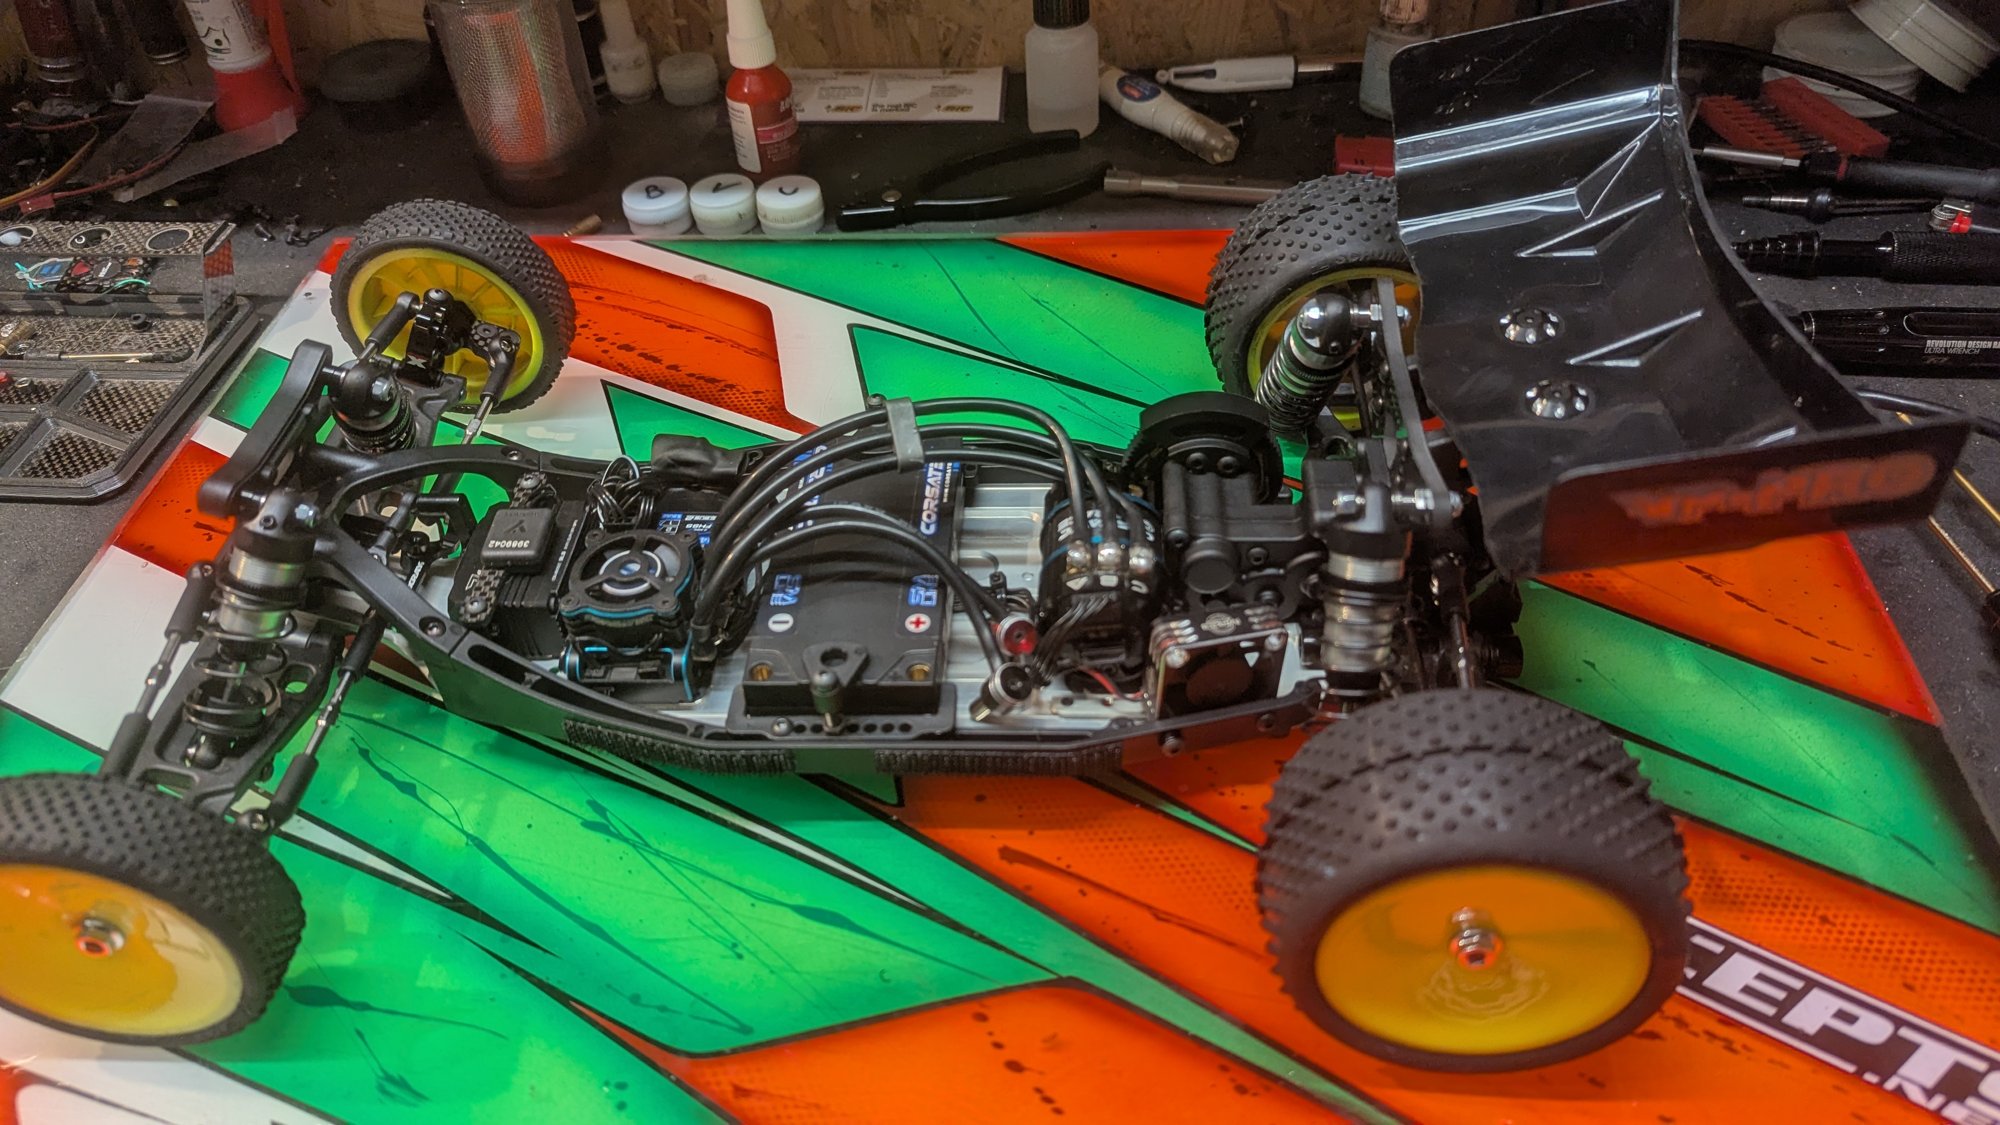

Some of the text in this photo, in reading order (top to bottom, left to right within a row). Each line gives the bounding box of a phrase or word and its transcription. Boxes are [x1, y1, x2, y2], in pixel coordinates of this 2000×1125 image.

[645, 184, 665, 199] B
[1926, 339, 1967, 348] REVOLUTION
[1967, 340, 1992, 348] DESIGN
